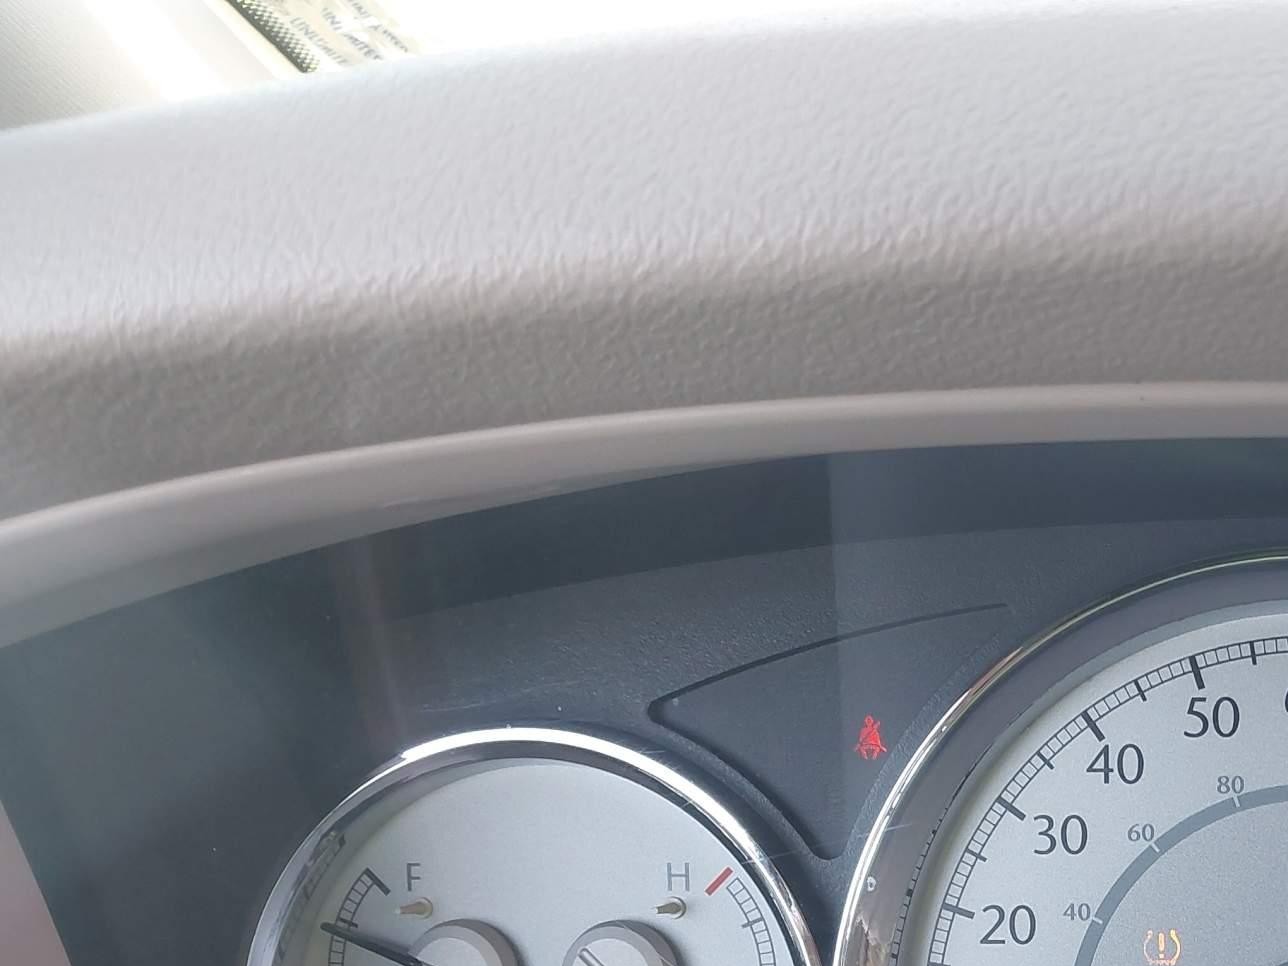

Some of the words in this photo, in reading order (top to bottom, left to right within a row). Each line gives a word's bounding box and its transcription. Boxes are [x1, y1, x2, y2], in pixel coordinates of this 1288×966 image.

[1184, 697, 1239, 737] 50
[1087, 744, 1144, 784] 40
[1217, 776, 1245, 794] 80
[1034, 815, 1087, 854] 30
[1128, 824, 1155, 842] 60
[407, 863, 420, 891] F
[667, 863, 689, 891] H
[980, 905, 1036, 944] 20
[1064, 903, 1091, 922] 40
